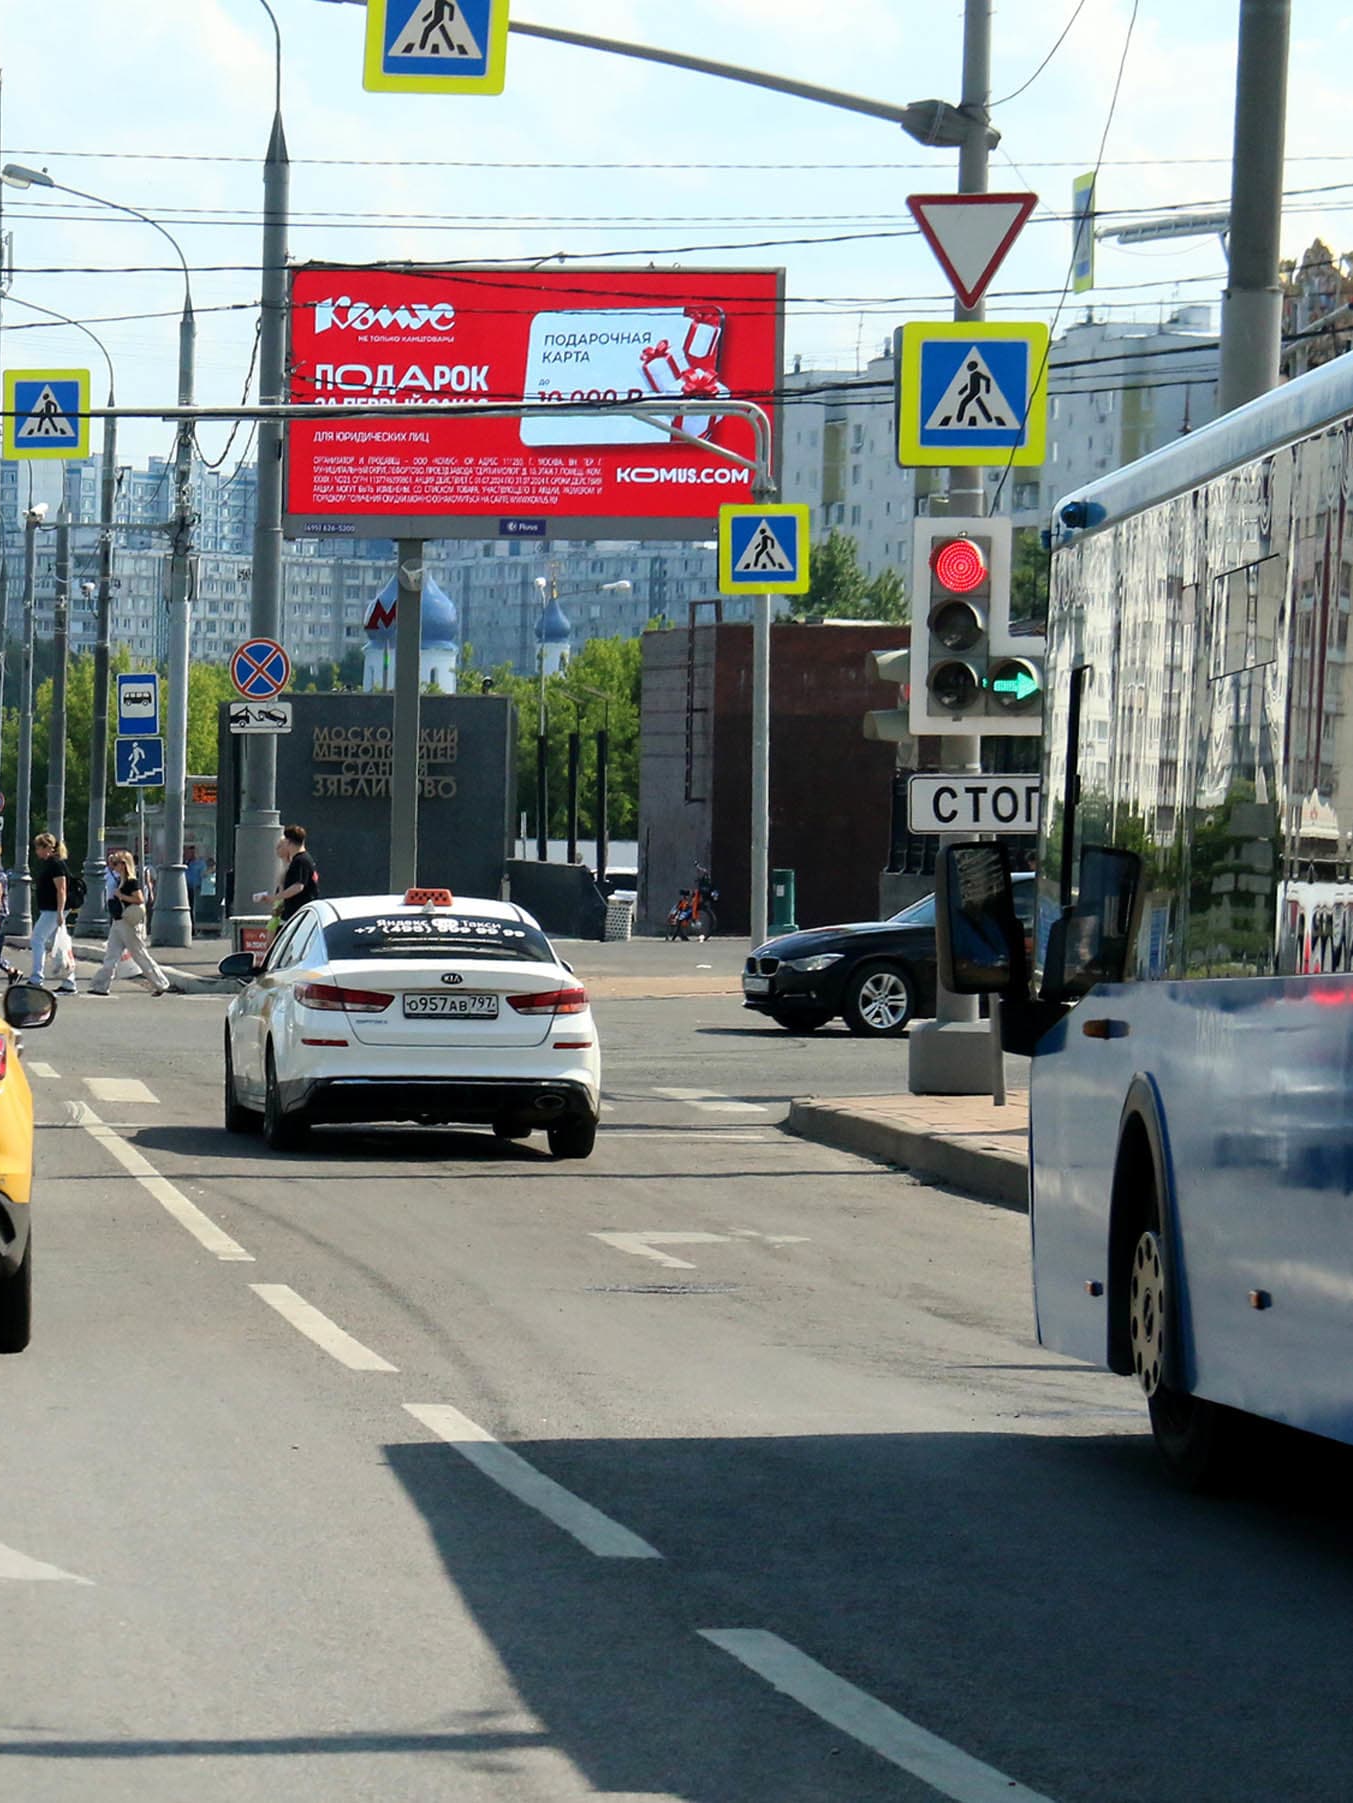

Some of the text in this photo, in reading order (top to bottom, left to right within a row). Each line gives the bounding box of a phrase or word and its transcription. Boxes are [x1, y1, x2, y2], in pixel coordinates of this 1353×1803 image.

[358, 335, 368, 343] НЕ
[544, 331, 652, 348] ПОДАРОЧНАЯ
[541, 351, 591, 364] КАРТА
[315, 363, 490, 396] ПОДАРОК
[313, 431, 430, 443] ДЛЯ ЮРИДИЧЕСКИХ ЛИЦ
[616, 467, 750, 485] KOMUS.COM
[313, 723, 459, 744] МОСКОКИЙ
[342, 761, 428, 777] СТАНЯ
[313, 776, 457, 798] ЗЯБЛИВО
[376, 919, 429, 929] Яндекс
[461, 919, 502, 929] Такси
[408, 996, 493, 1012] О957АВ 797
